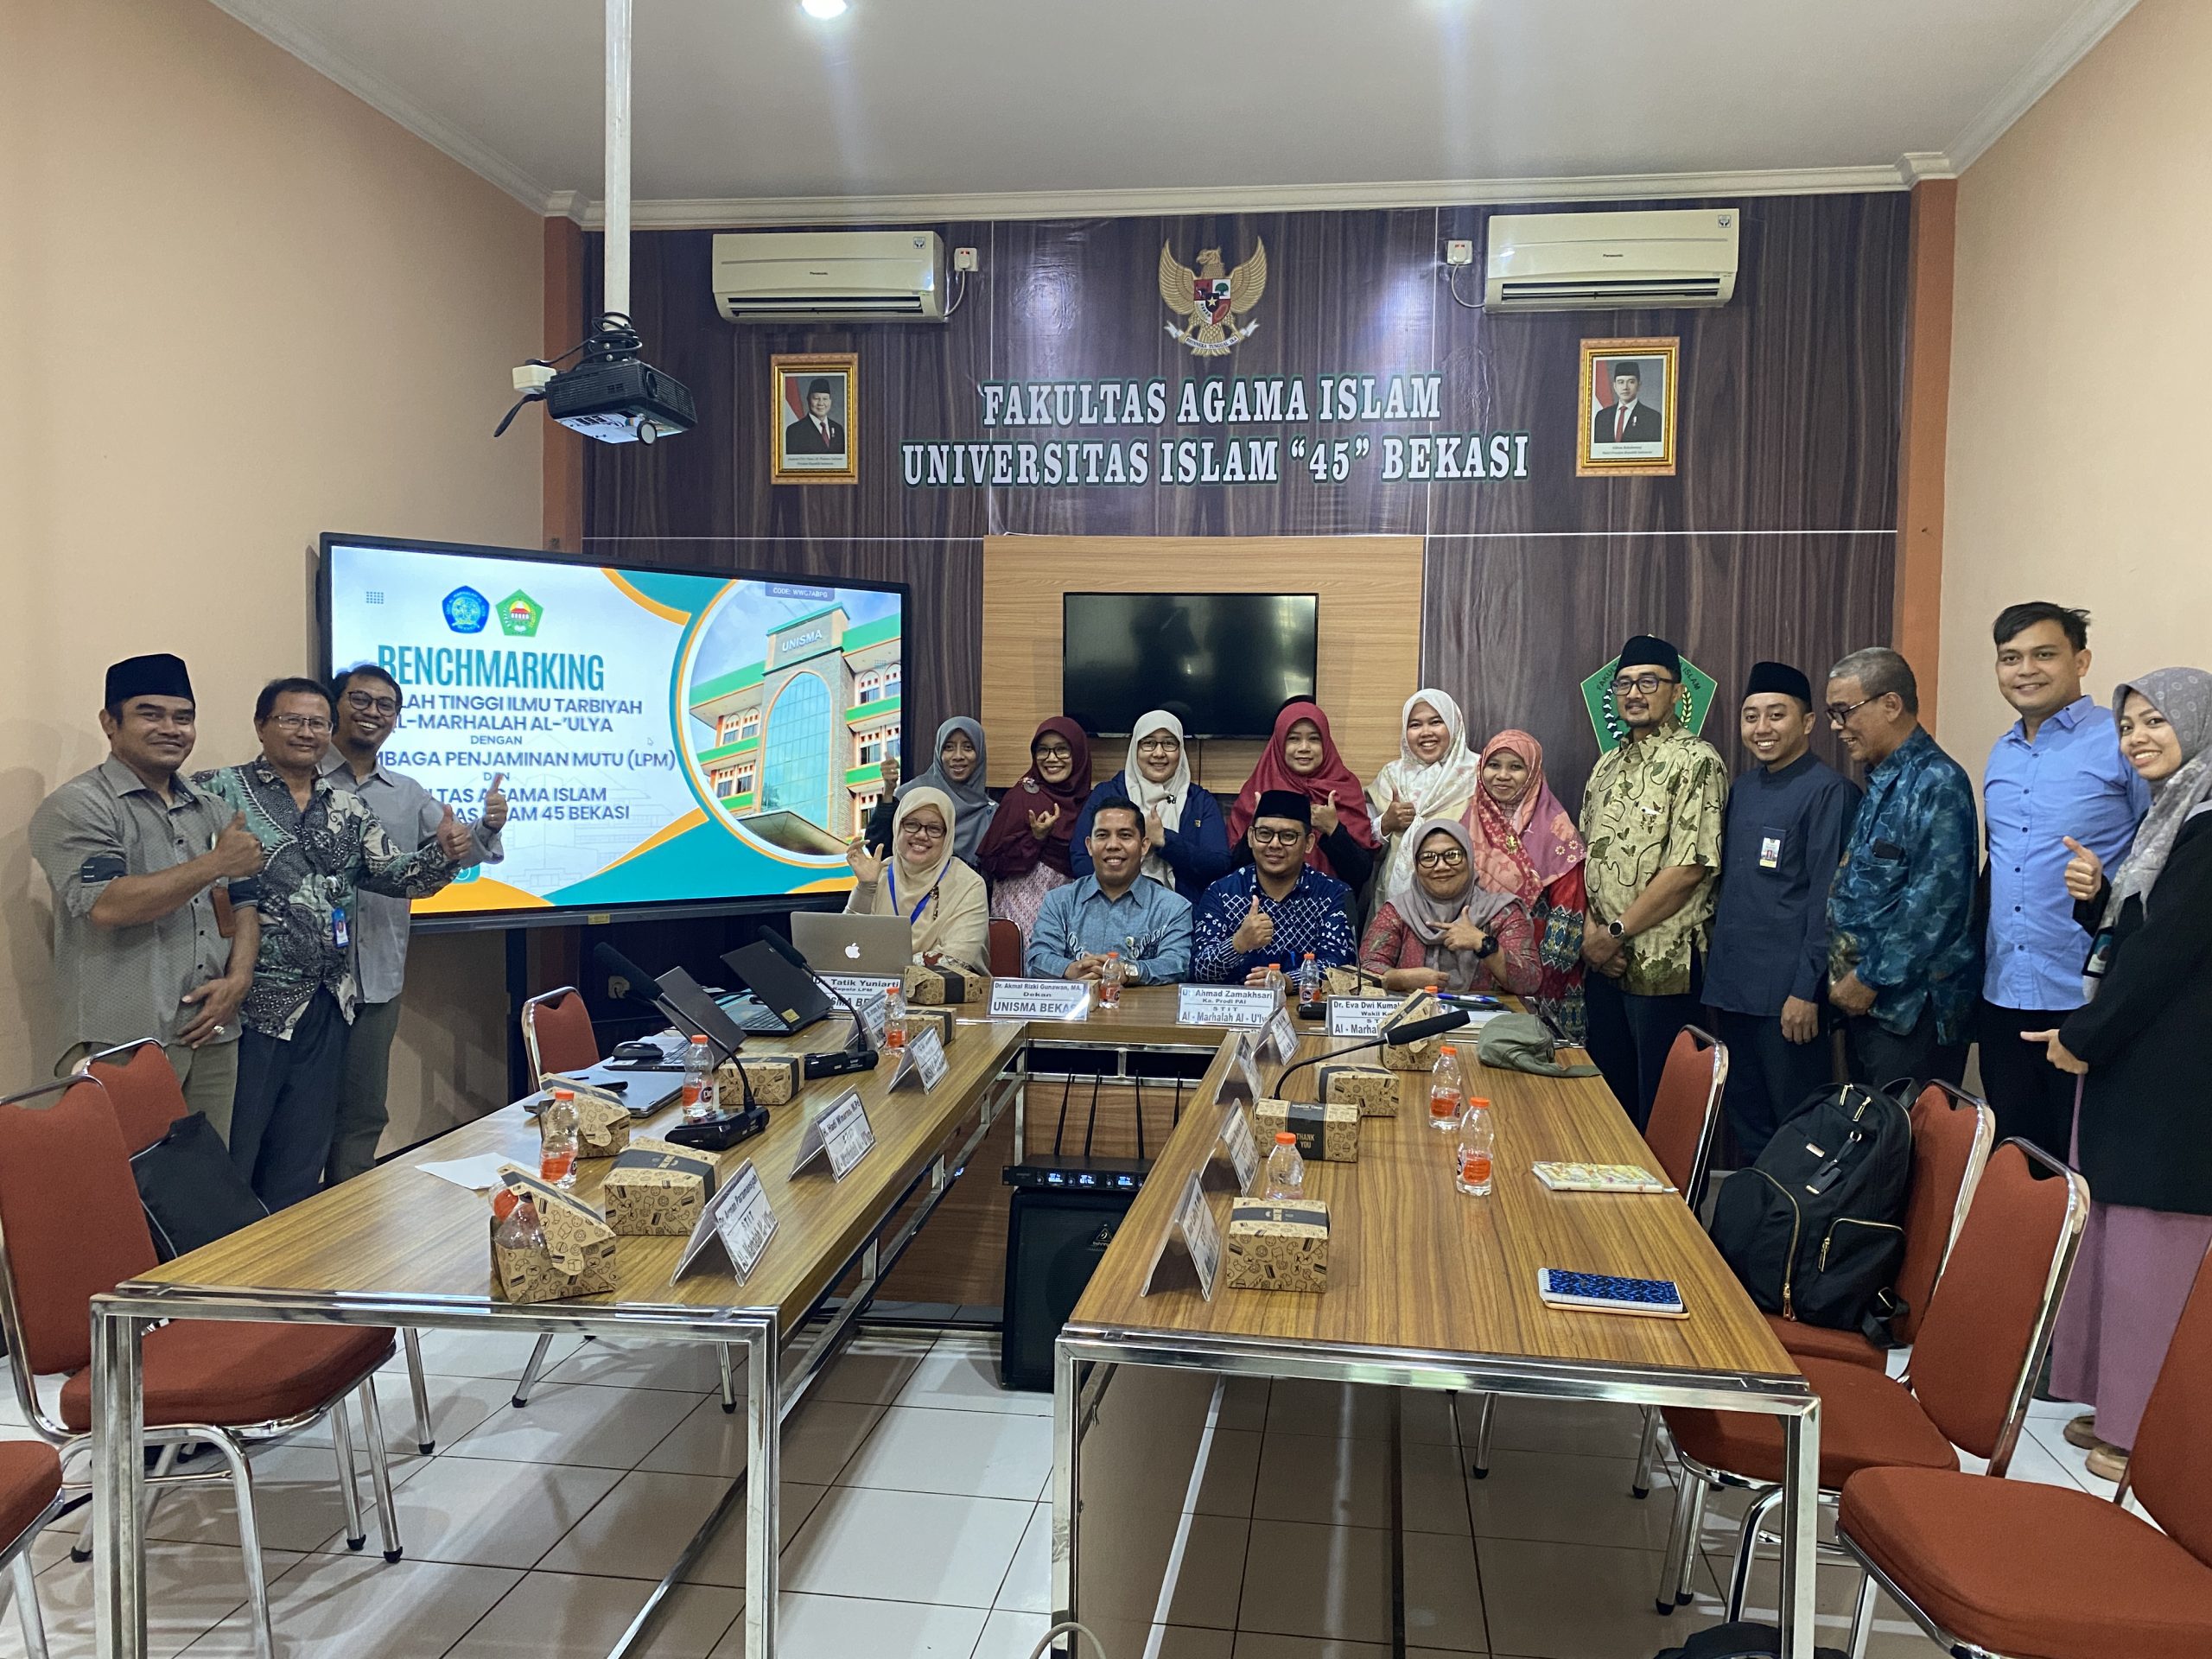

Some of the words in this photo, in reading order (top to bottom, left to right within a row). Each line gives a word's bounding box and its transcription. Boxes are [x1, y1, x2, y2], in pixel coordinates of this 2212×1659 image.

[983, 380, 1166, 426] FAKULTAS
[1177, 378, 1308, 422] AGAMA
[1319, 377, 1441, 420] ISLAM
[902, 442, 1149, 486] UNIVERSITAS
[1160, 441, 1278, 483] ISLAM
[1382, 435, 1529, 480] BEKASI
[782, 629, 823, 652] UNISMA
[378, 645, 605, 691] BENCHMARKING
[1682, 667, 1701, 690] ISLAM
[439, 695, 504, 711] TINGGI
[507, 696, 550, 712] ILMU
[554, 698, 643, 715] TARBIYAH
[394, 714, 527, 731] L-MARHALAH
[471, 735, 523, 746] DENGAN
[375, 751, 442, 766] MBAGA
[446, 751, 570, 766] PENJAMINAN
[573, 753, 623, 766] MUTU
[627, 749, 676, 771] (LPM)
[484, 772, 510, 781] DN
[554, 787, 607, 802] ISLAM
[543, 806, 563, 820] 45
[569, 804, 629, 820] BEKASI
[1225, 990, 1273, 1000] Zamakhsari
[993, 1001, 1036, 1012] UNISMA
[1197, 1012, 1233, 1022] Marhalah
[1300, 1141, 1312, 1149] YOU
